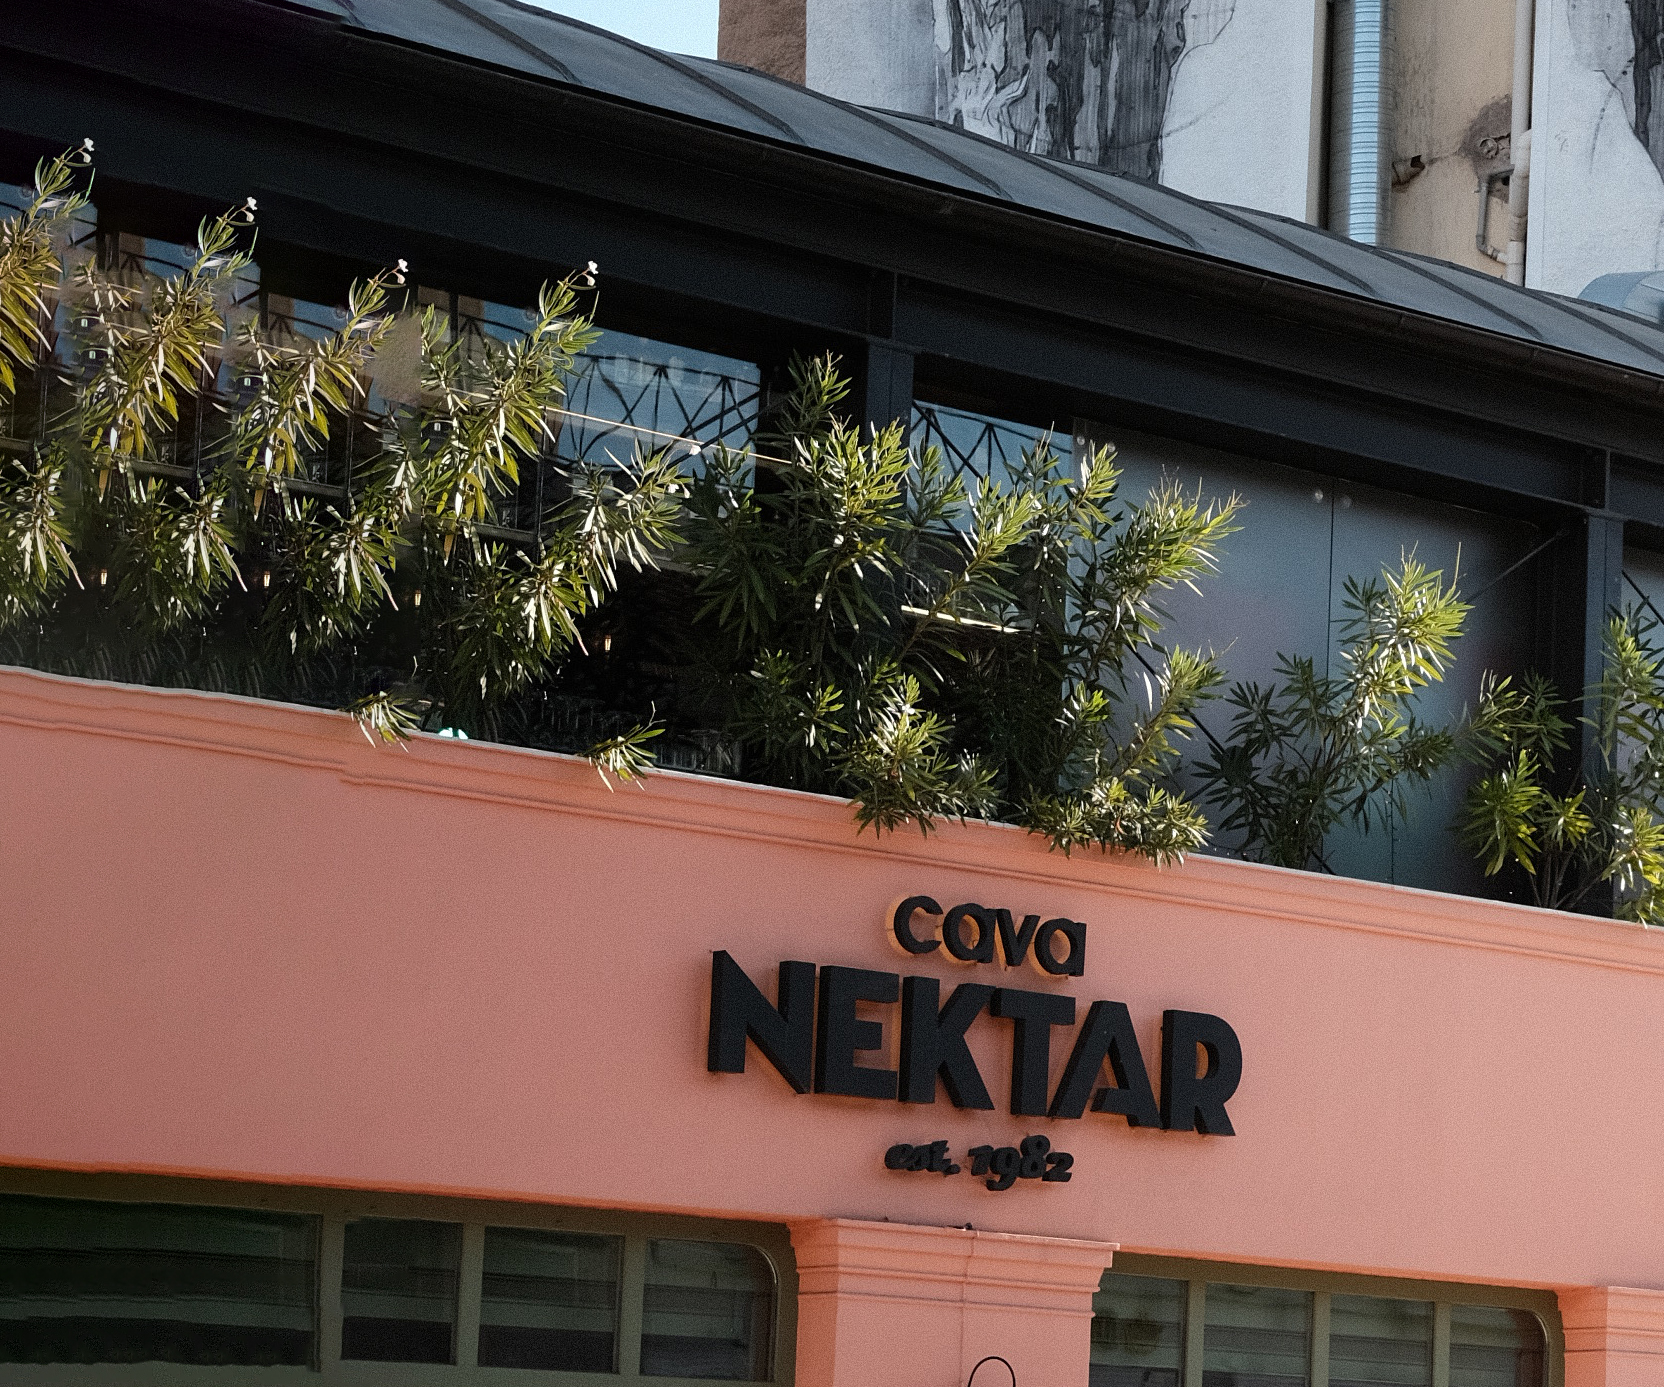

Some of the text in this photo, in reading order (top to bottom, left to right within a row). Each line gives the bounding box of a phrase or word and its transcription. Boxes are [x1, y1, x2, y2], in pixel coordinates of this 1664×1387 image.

[893, 895, 1087, 978] cava
[707, 949, 1244, 1137] NEKTAR
[884, 1134, 1075, 1192] est. 1982
